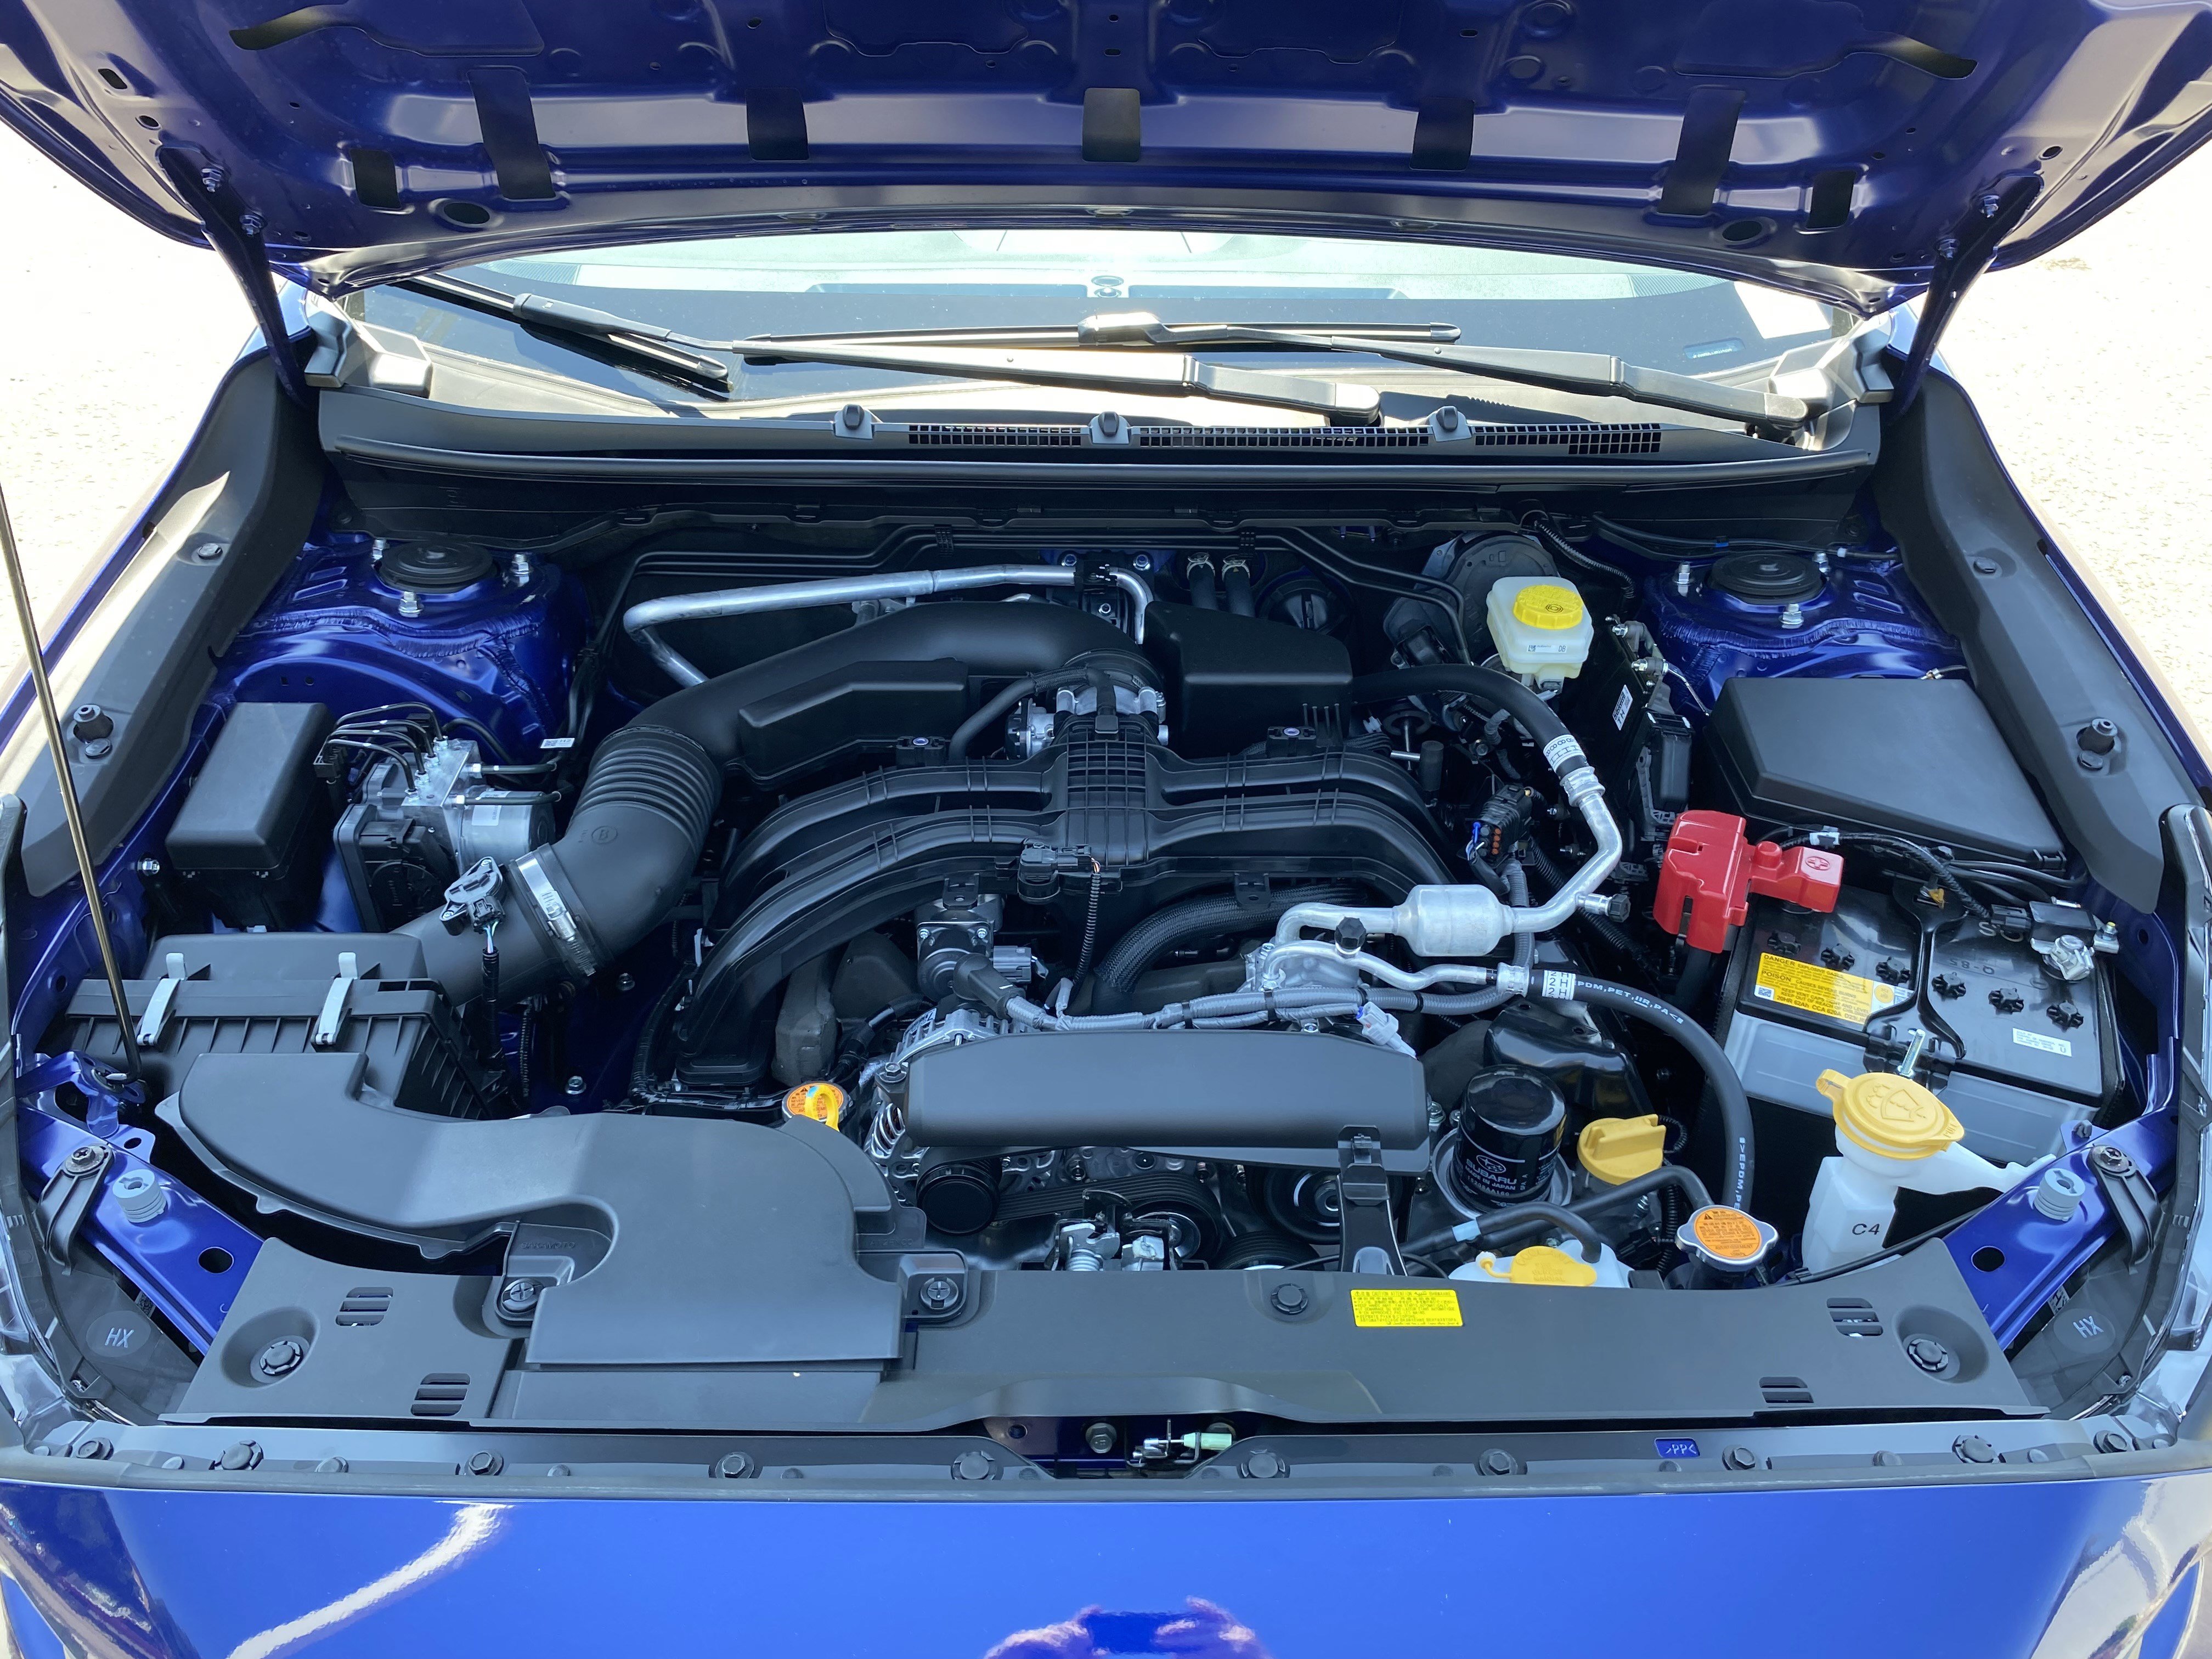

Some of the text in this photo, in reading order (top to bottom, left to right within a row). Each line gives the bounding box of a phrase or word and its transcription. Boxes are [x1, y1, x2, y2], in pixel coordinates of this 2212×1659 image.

[1763, 955, 1796, 966] DANGER
[1797, 963, 1826, 973] EXPLOSIVE
[1549, 978, 1568, 988] 2 H
[1761, 970, 1792, 982] POISON
[1547, 988, 1555, 996] 2
[1777, 995, 1793, 1004] 20HR
[1793, 1000, 1809, 1008] 62Ah
[1812, 1005, 1826, 1013] CCA
[1465, 1165, 1481, 1181] MADE
[1492, 1182, 1516, 1190] JAPAN
[1466, 1158, 1517, 1185] SUBARU
[1852, 1223, 1880, 1235] C4
[1515, 1249, 1576, 1266] COOLANT
[2073, 1316, 2104, 1338] HX
[104, 1327, 134, 1348] HX
